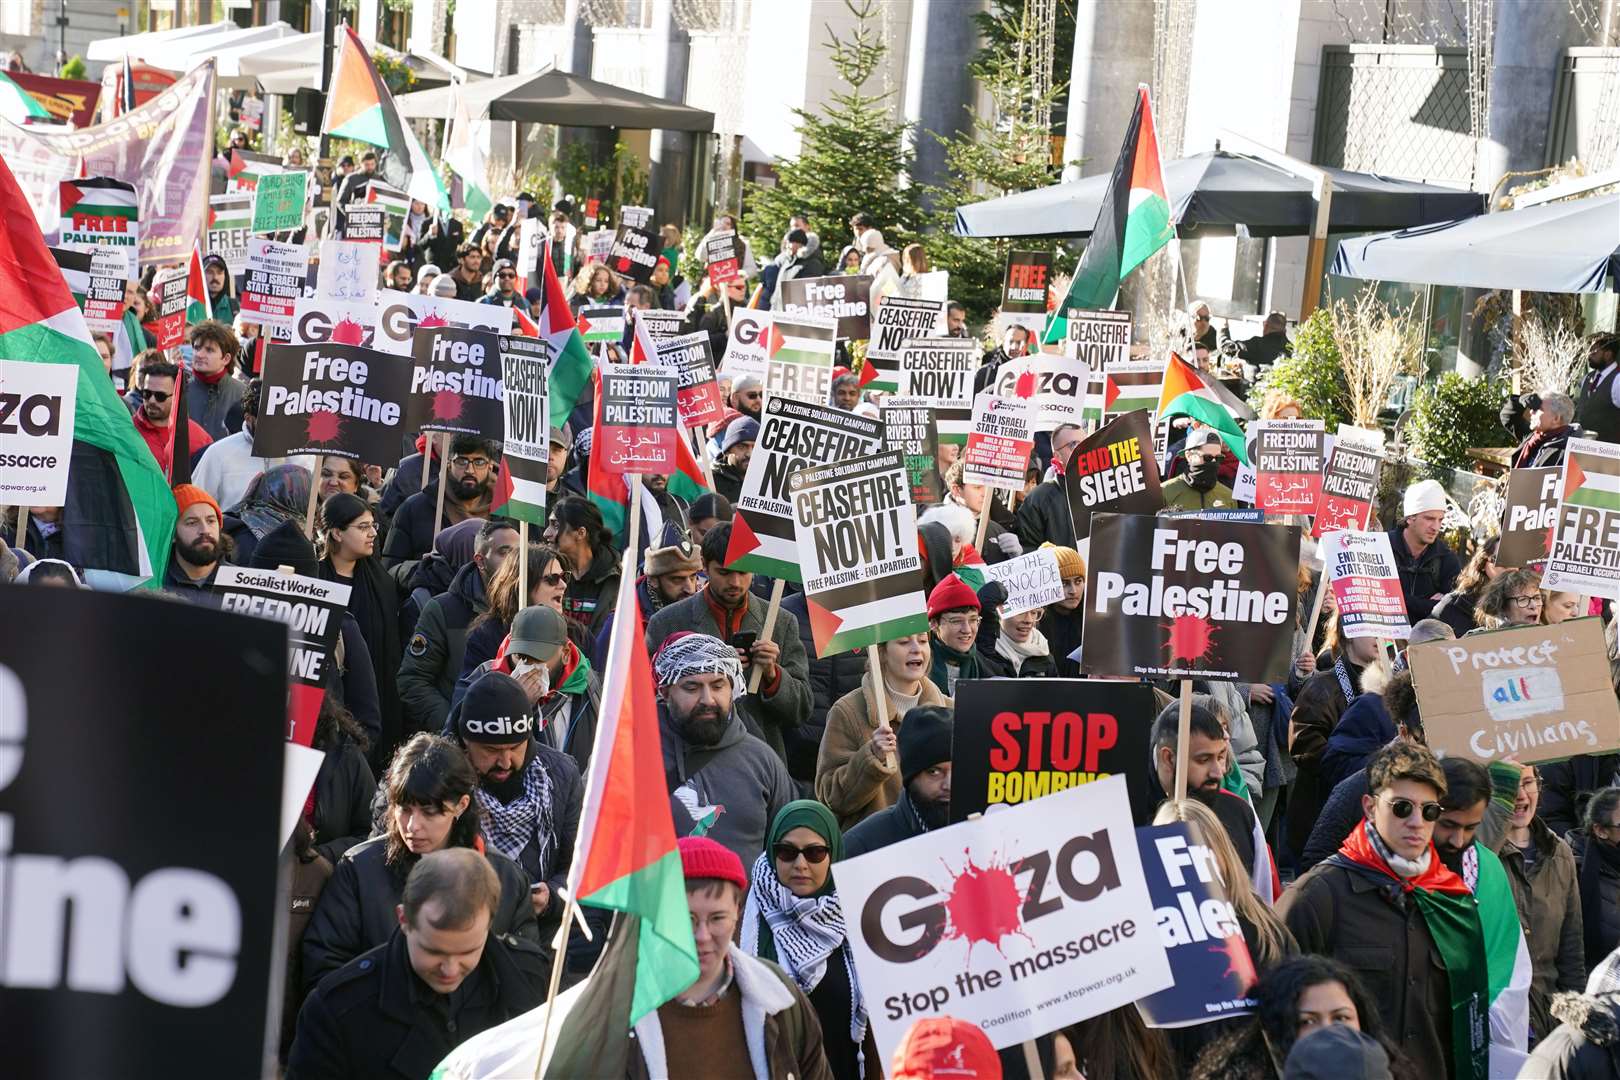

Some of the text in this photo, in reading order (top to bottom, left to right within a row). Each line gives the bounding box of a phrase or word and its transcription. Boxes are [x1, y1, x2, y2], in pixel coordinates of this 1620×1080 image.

[72, 213, 128, 232] FREE
[348, 211, 381, 225] FREEDOM
[346, 227, 383, 238] PALESTINE
[92, 279, 120, 290] ISRAELI
[251, 271, 299, 287] END ISRAELI
[1010, 264, 1048, 289] FREE
[94, 290, 123, 301] TERROR
[246, 280, 270, 294] STATE
[271, 283, 302, 298] TERROR
[805, 283, 846, 300] Free
[1008, 288, 1046, 302] PALESTINE
[162, 297, 187, 316] PALESTINE
[786, 300, 868, 318] Palestine
[878, 307, 939, 329] CEASEFIRE
[1070, 321, 1129, 345] CEASEFIRE
[432, 334, 485, 366] Free
[659, 344, 705, 367] FREEDOM
[730, 350, 750, 361] Stop
[302, 351, 369, 385] Free
[904, 351, 973, 371] CEASEFIRE
[411, 366, 503, 401] Palestine
[504, 357, 547, 396] CEASEFIRE
[767, 363, 830, 394] FREE
[909, 371, 964, 398] NOW!
[609, 379, 670, 398] FREEDOM
[266, 386, 400, 426] Palestine
[634, 396, 646, 406] for
[509, 392, 544, 445] NOW!
[605, 405, 673, 425] PALESTINE
[783, 403, 877, 433] PALESTINE SOLIDARITY CAMPAIGN
[885, 409, 930, 425] FROM THE
[982, 412, 1027, 429] END ISRAELI
[616, 431, 661, 446] الحرية
[761, 418, 873, 464] CEASEFIRE
[886, 424, 927, 440] RIVER TO
[976, 422, 1028, 439] STATE TERROR
[1263, 433, 1317, 449] FREEDOM
[610, 448, 667, 465] لفلسطين
[886, 440, 923, 455] THE SEA
[1077, 437, 1142, 476] END THE
[1286, 448, 1295, 456] for
[1571, 443, 1598, 453] Palestine
[805, 454, 898, 482] PALESTINE SOLIDARITY CAMPAIGN
[1260, 456, 1320, 472] PALESTINE
[1332, 451, 1377, 475] FREEDOM
[1079, 460, 1147, 507] SIEGE
[1325, 474, 1373, 499] PALESTINE
[742, 496, 793, 517] FREE PALESTINE
[797, 473, 906, 528] CEASEFIRE
[1200, 512, 1259, 521] SOLIDARITY CAMPAIGN
[813, 510, 904, 575] NOW!
[1151, 528, 1244, 575] Free
[988, 554, 1048, 579] STOP THE
[1337, 552, 1384, 565] END ISRAELI
[1551, 561, 1566, 571] END
[1566, 563, 1593, 575] ISRAELI
[807, 557, 918, 591] FREE PALESTINE END APARTHEID
[1003, 563, 1058, 594] ENOCIDE
[1335, 564, 1392, 577] STATE TERROR
[1008, 584, 1064, 608] FREE PALESTINE
[1095, 571, 1289, 625] Palestine
[220, 591, 331, 637] FREEDOM
[1343, 614, 1356, 623] FOR
[1356, 613, 1361, 622] A
[1446, 639, 1558, 675] Protect
[1134, 666, 1147, 675] Stop
[1147, 666, 1156, 674] the
[1168, 668, 1189, 676] Coalition
[1189, 668, 1239, 678] www.stopwar.org.uk
[1492, 676, 1531, 704] all
[990, 711, 1119, 772] STOP
[1470, 720, 1598, 759] Civilians
[884, 916, 1137, 1022] Stop the massacre
[981, 965, 1139, 1030] Coalition www.stopwar.org.uk
